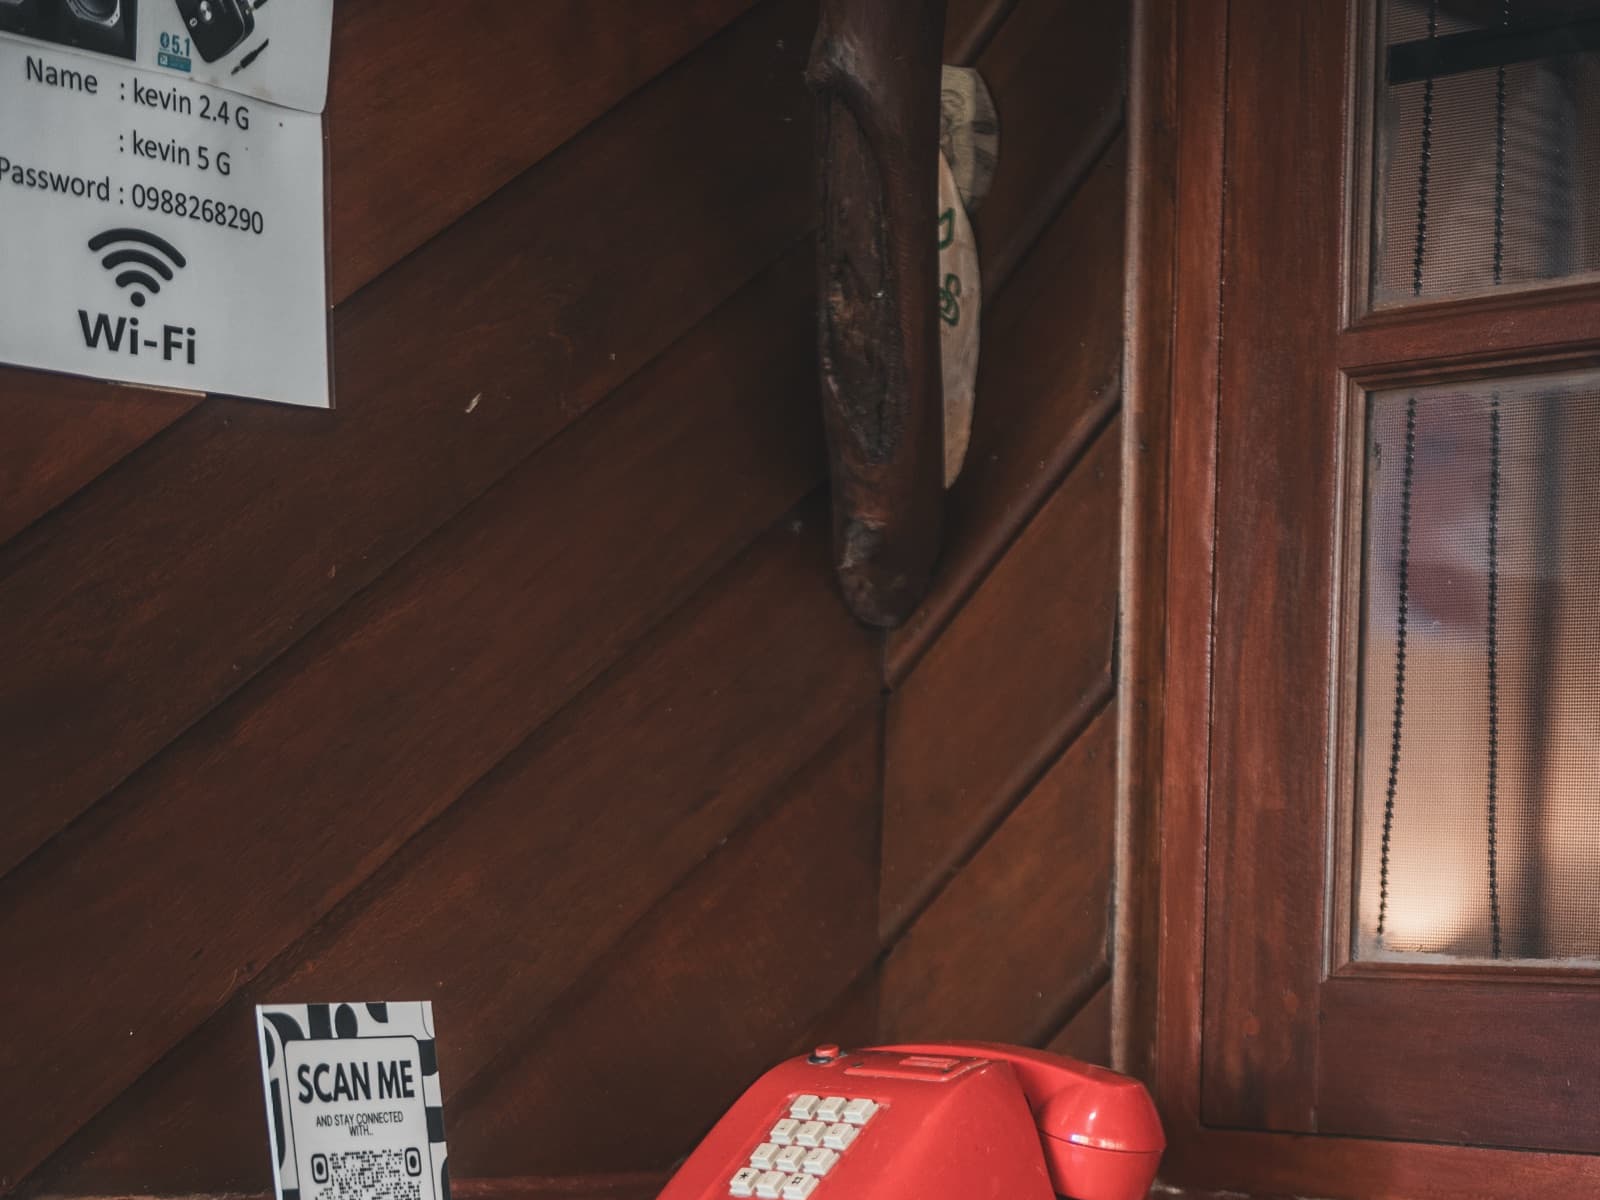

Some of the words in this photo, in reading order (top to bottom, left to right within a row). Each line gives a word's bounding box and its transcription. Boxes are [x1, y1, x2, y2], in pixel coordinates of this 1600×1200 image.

[172, 34, 191, 57] 5.1
[25, 55, 99, 94] Name
[133, 77, 192, 116] kevin
[199, 94, 230, 126] 2.4
[235, 106, 250, 131] G
[132, 129, 190, 166] kevin
[198, 145, 210, 171] 5
[216, 151, 231, 176] G
[0, 156, 110, 202] Password
[131, 183, 264, 235] 0988268290
[77, 308, 196, 365] Wi-Fi
[297, 1061, 372, 1105] SCAN
[377, 1059, 415, 1100] ME
[315, 1114, 334, 1128] AND
[334, 1113, 355, 1127] STAY
[356, 1111, 404, 1125] CONNECTED
